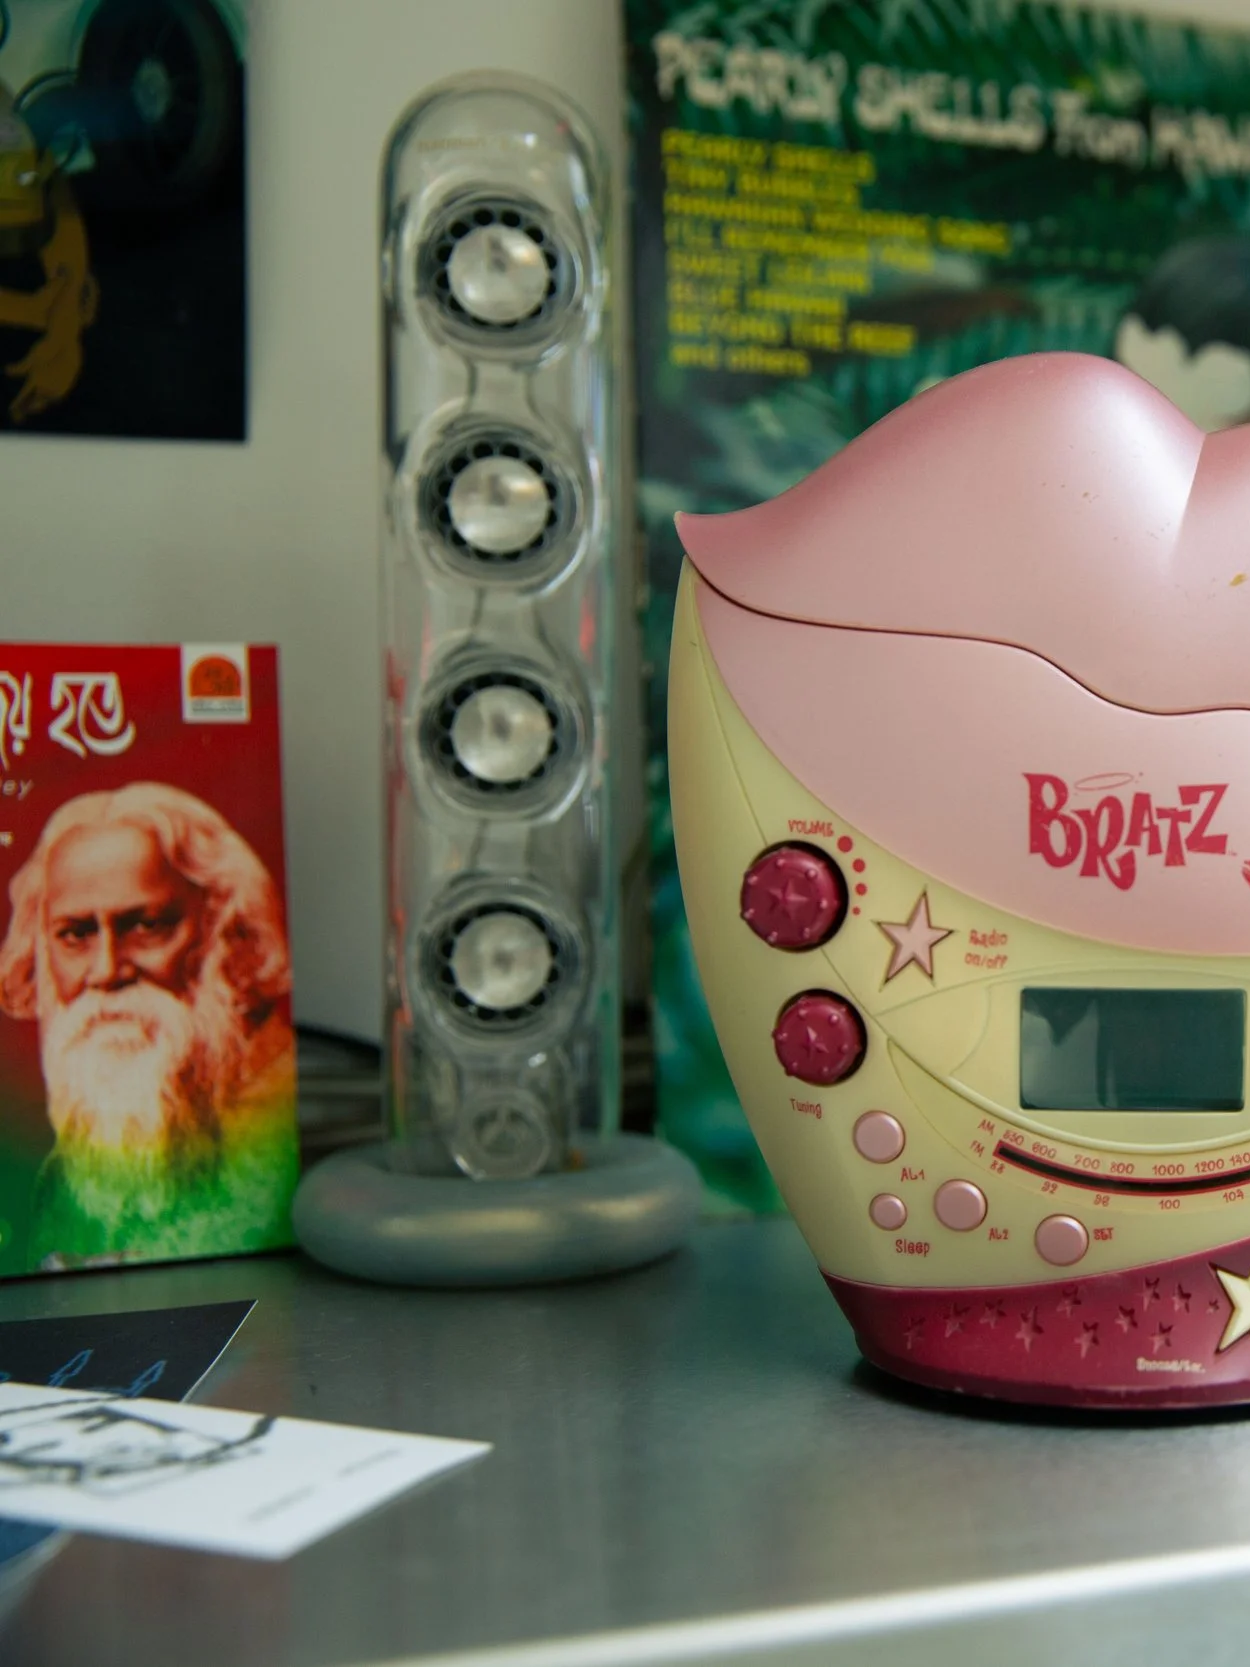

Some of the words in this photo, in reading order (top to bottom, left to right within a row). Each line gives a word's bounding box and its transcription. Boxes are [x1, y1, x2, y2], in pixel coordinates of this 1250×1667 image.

[654, 33, 847, 124] PEARLY
[854, 64, 1044, 152] SHELLS
[0, 778, 33, 801] ey
[788, 819, 834, 838] VOLUME
[969, 928, 1008, 949] Radio
[964, 952, 1008, 970] on/off
[790, 1099, 822, 1119] Tuning
[977, 1119, 995, 1135] AM
[1002, 1129, 1025, 1146] 530
[1074, 1154, 1101, 1170] 700
[1152, 1164, 1184, 1176] 1000
[1194, 1158, 1225, 1173] 1200
[901, 1168, 925, 1182] AL1
[970, 1140, 986, 1157] FM
[989, 1160, 1005, 1174] 88
[1041, 1181, 1058, 1194] 92
[1159, 1199, 1181, 1210] 100
[1223, 1189, 1244, 1203] 104
[988, 1228, 1009, 1241] AL2
[1093, 1228, 1114, 1240] SET
[895, 1239, 930, 1257] Sleep
